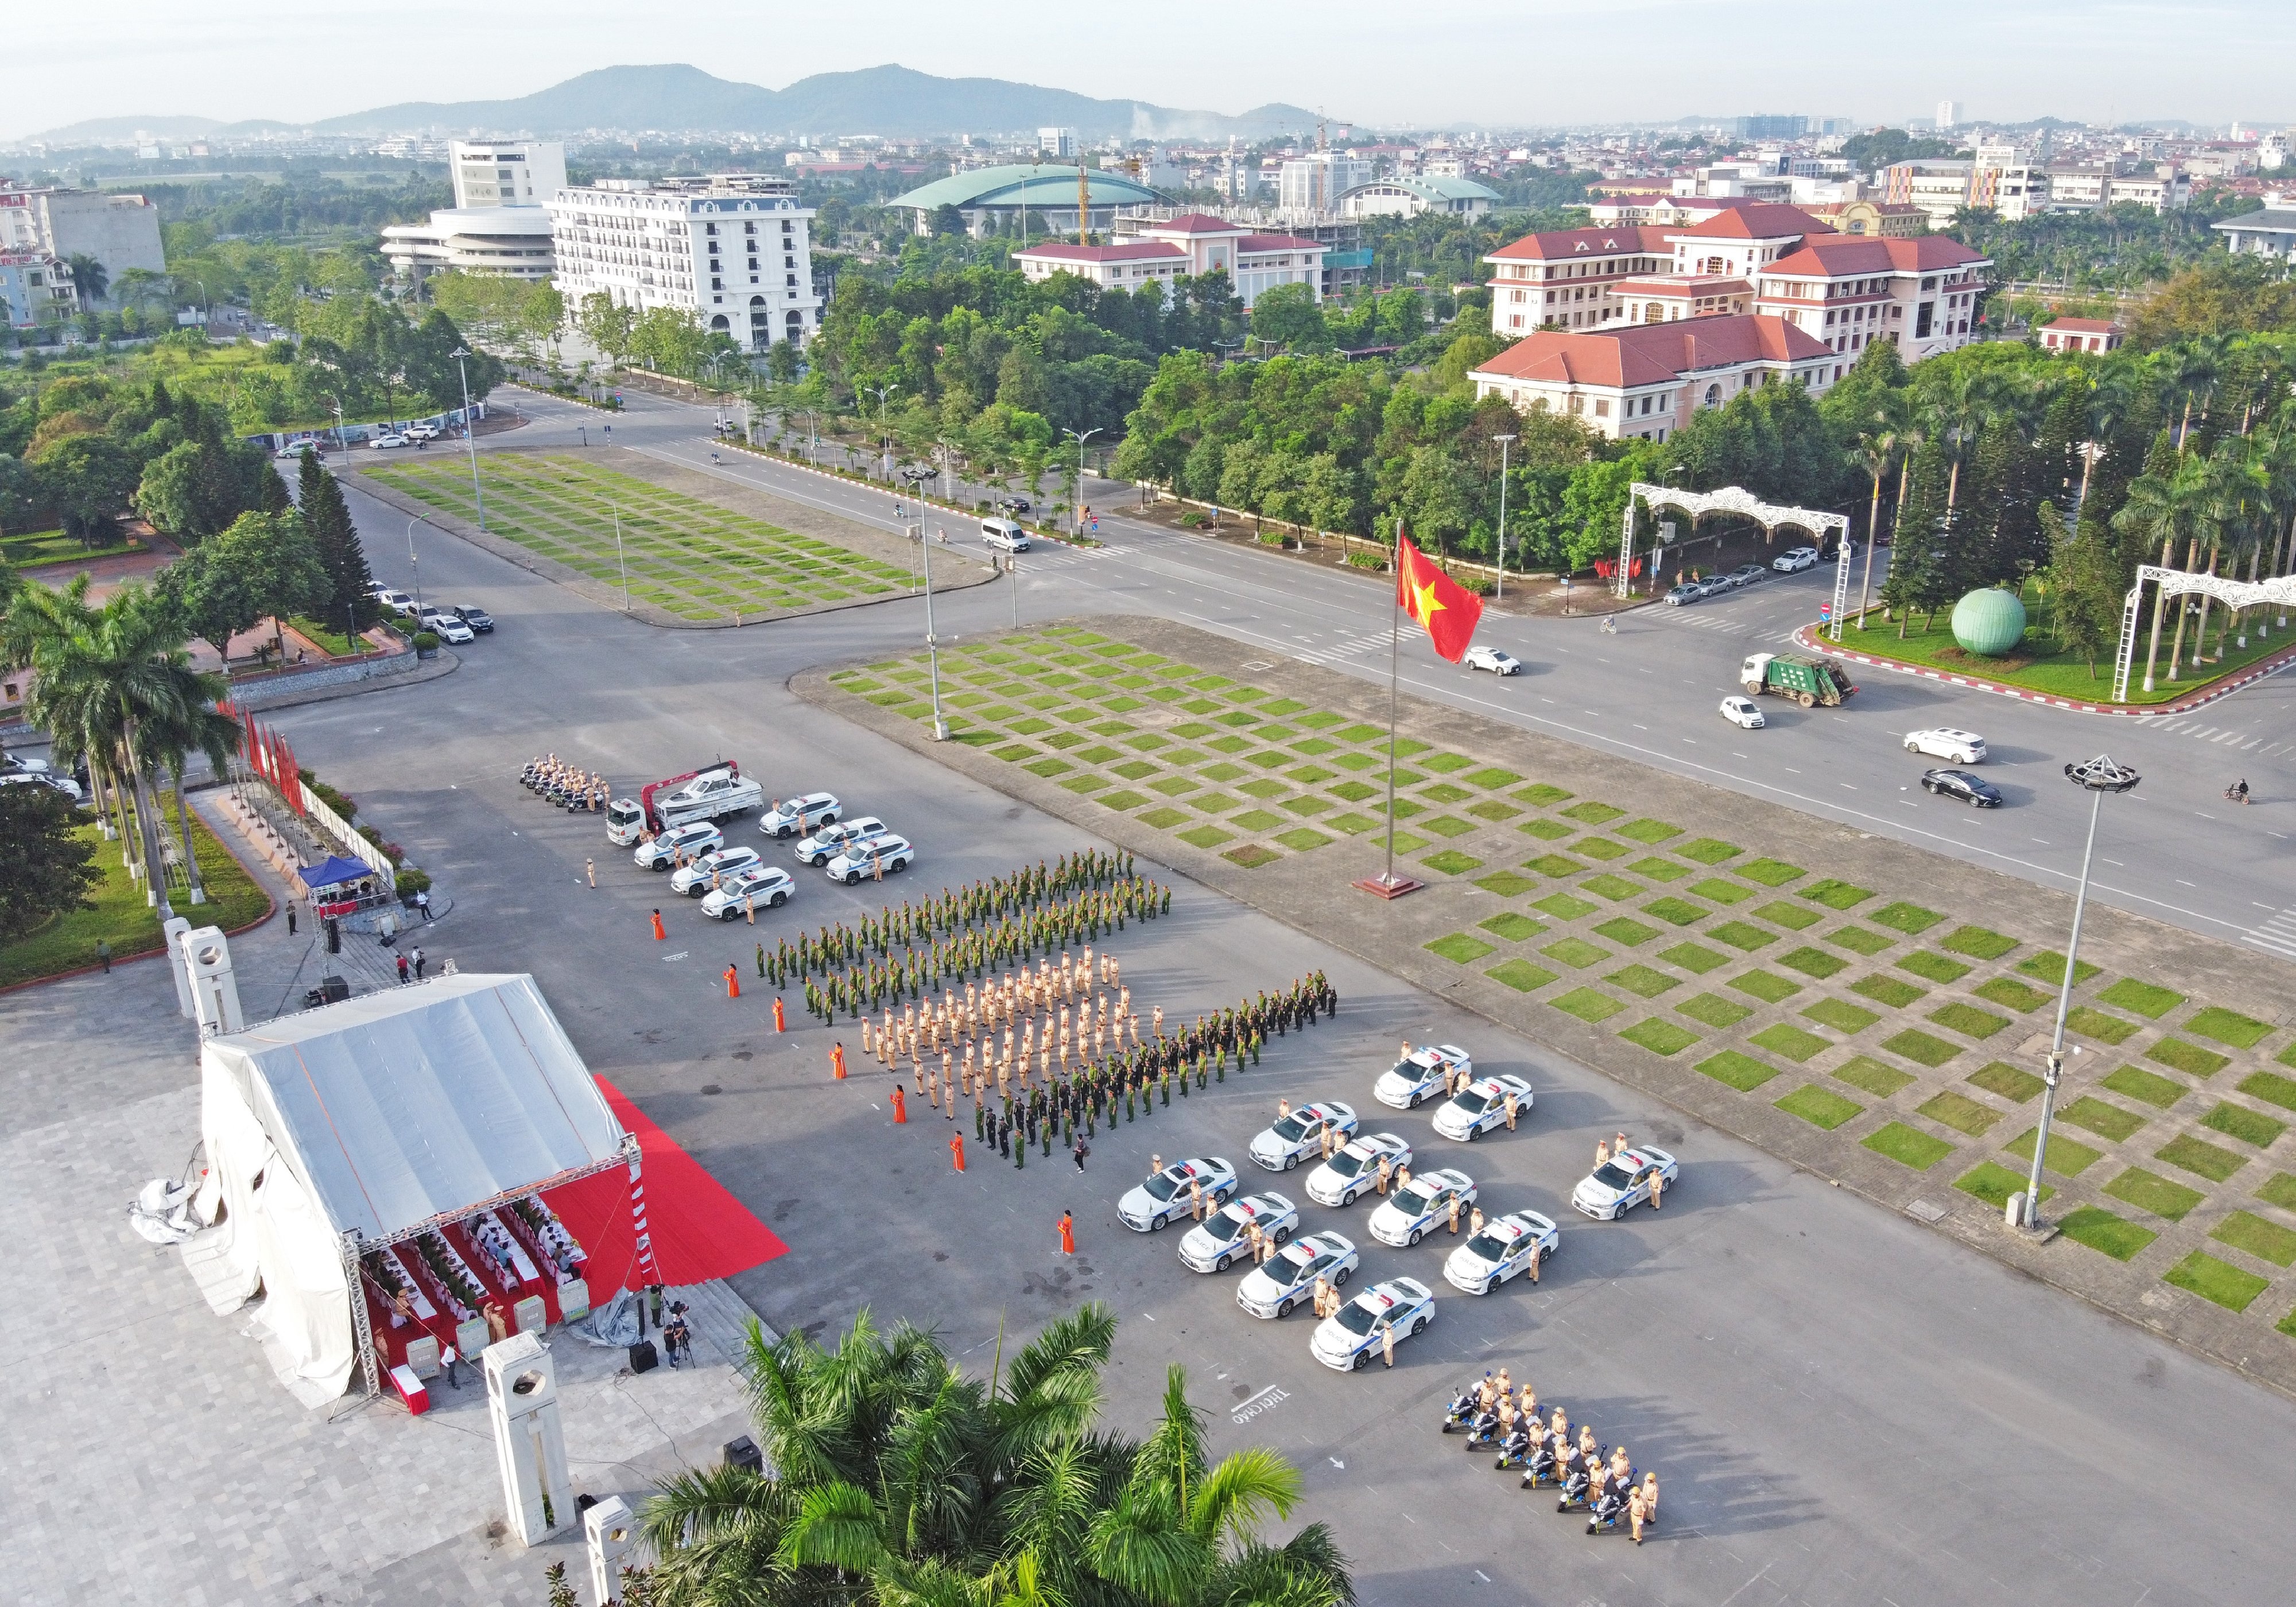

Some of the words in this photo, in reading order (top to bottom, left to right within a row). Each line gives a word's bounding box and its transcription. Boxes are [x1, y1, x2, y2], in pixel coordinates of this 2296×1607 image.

[1583, 1184, 1609, 1200] POLICE
[1188, 1235, 1211, 1252] POLICE
[1459, 1256, 1479, 1269] POLICE
[1325, 1329, 1345, 1344] POLICE
